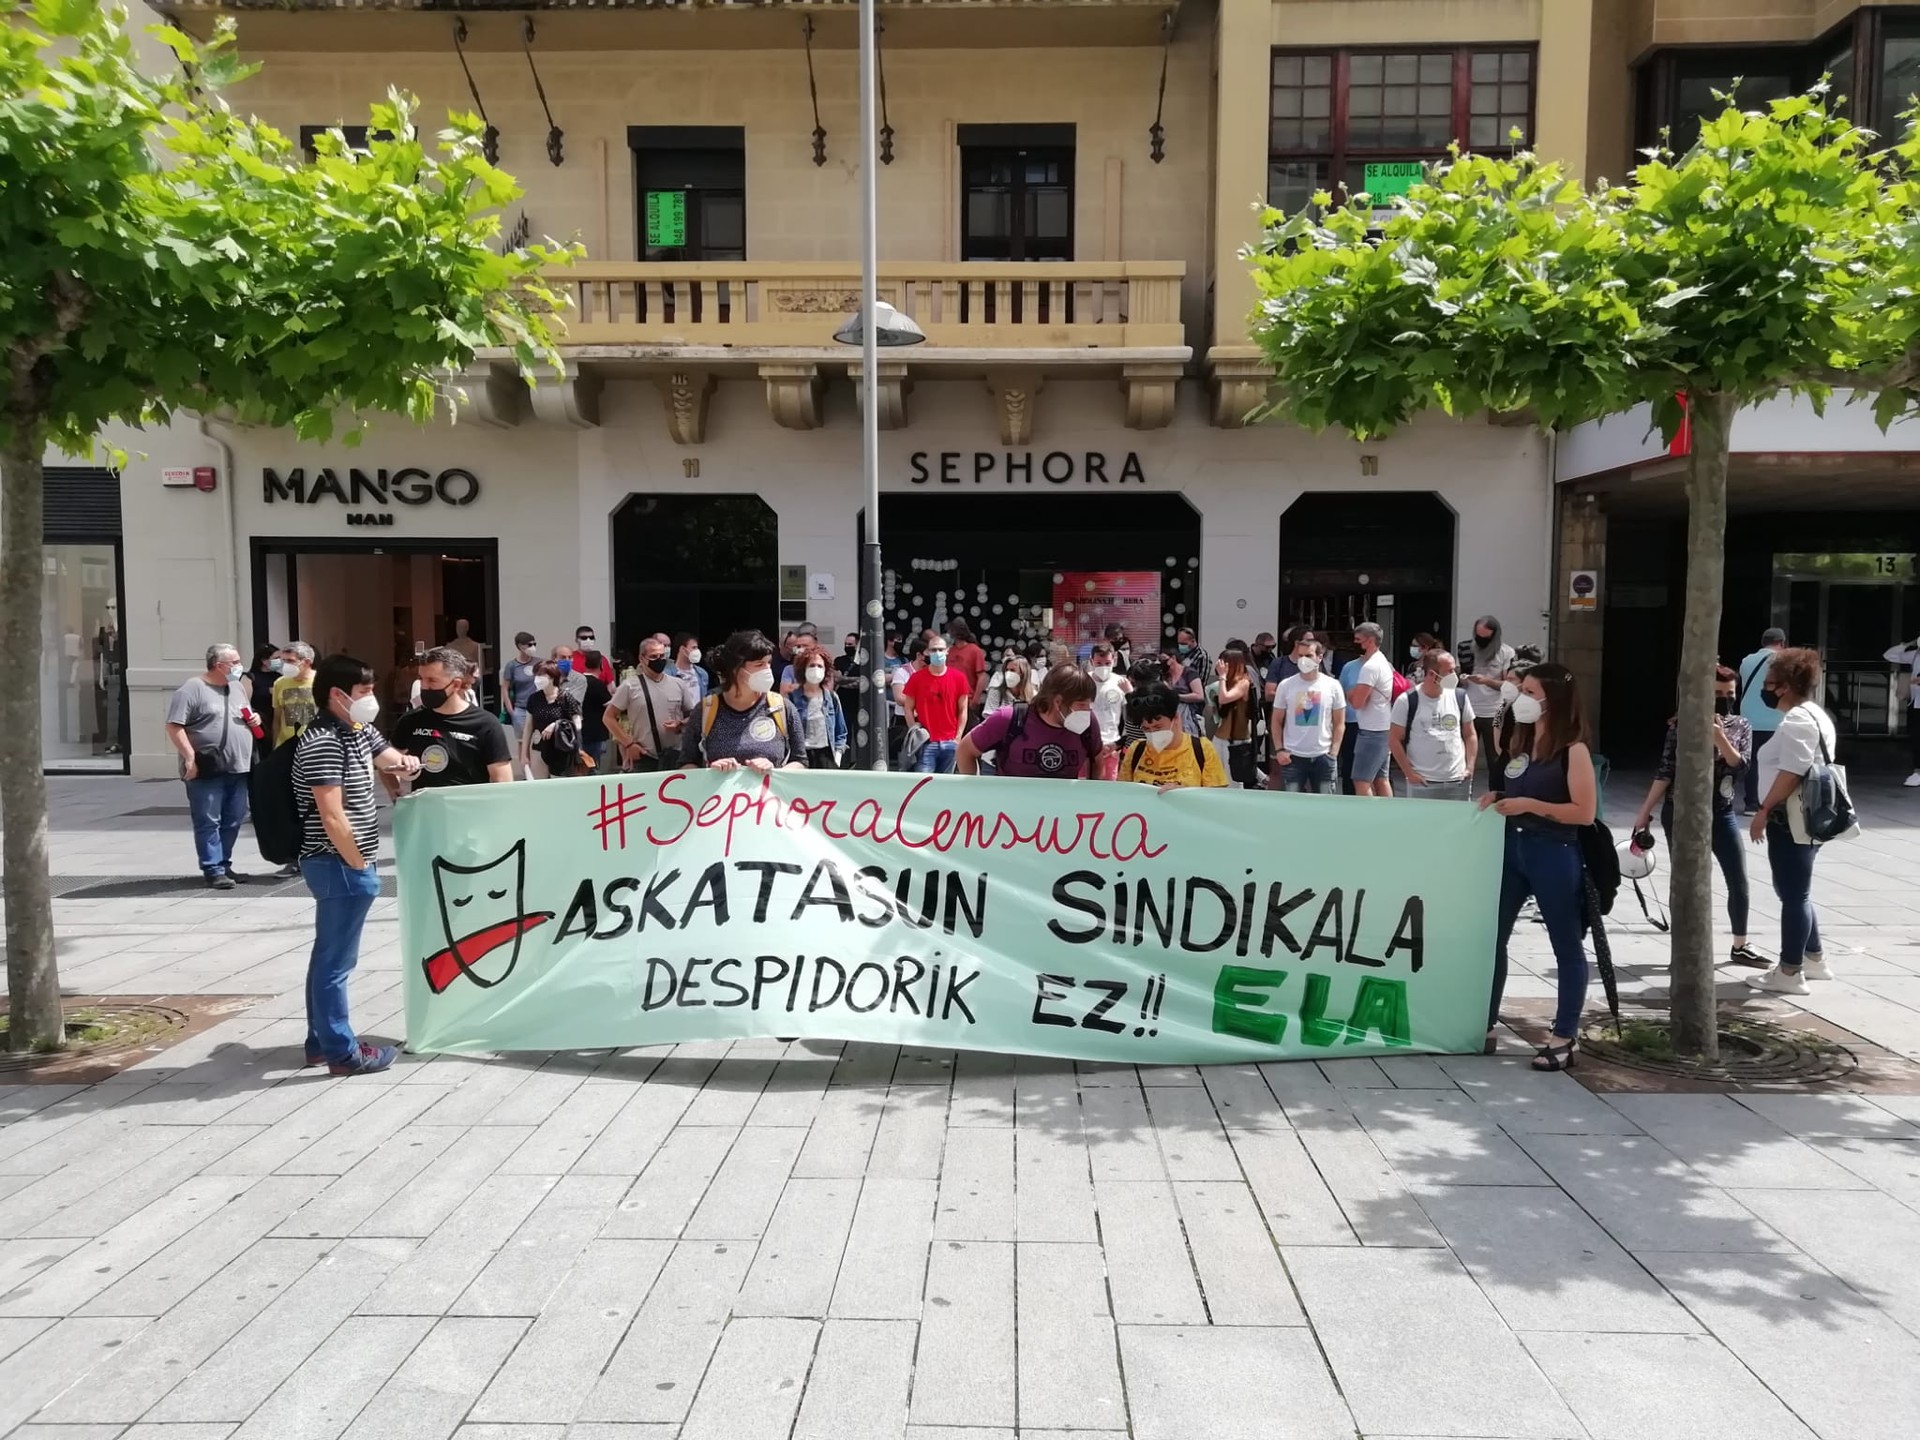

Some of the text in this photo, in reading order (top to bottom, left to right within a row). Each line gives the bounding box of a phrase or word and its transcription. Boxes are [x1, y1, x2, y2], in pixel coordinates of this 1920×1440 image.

[1366, 164, 1420, 178] SE ALQUILA
[649, 193, 660, 244] SE ALQUILA
[682, 458, 700, 478] 11
[910, 451, 1145, 484] SEPHORA
[1360, 455, 1378, 476] 11
[262, 468, 479, 505] MANGO
[346, 513, 393, 526] MAN
[1875, 556, 1896, 574] 13
[412, 727, 432, 736] JACK
[587, 773, 1168, 861] #SephoraCensura
[552, 858, 988, 944] ASKATASUN
[1032, 972, 1166, 1037] EZ!!
[1212, 964, 1412, 1046] ELA
